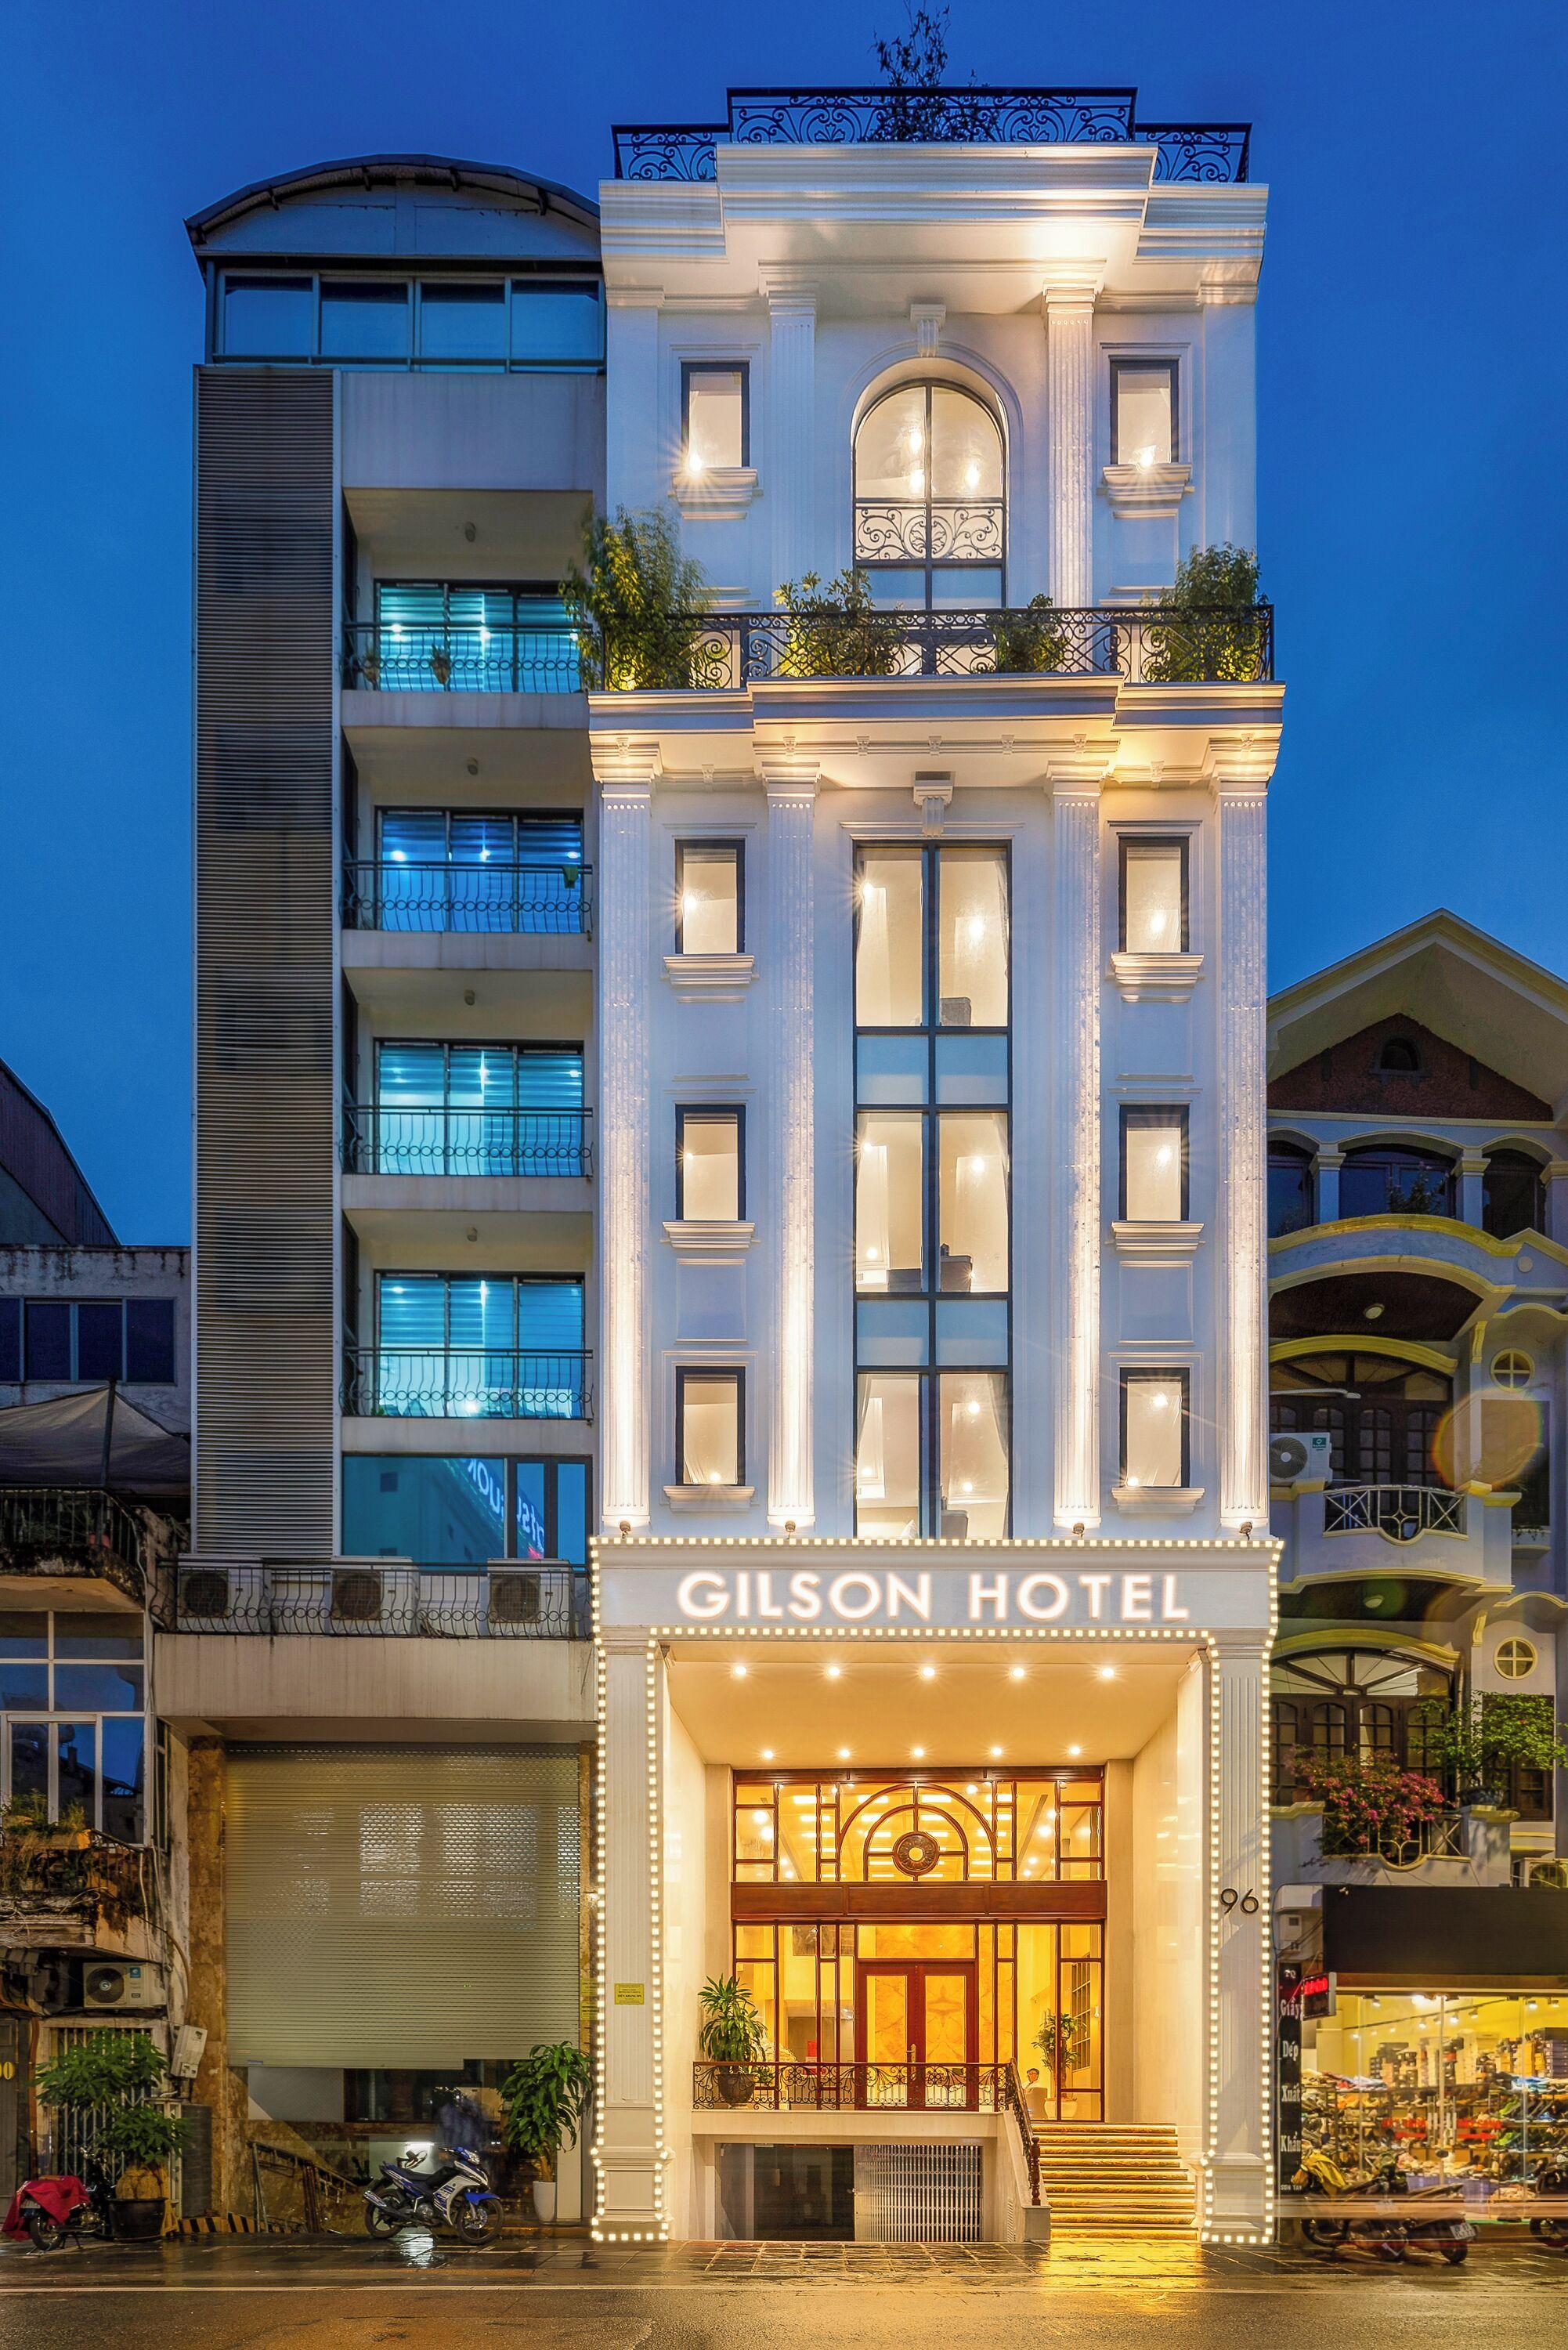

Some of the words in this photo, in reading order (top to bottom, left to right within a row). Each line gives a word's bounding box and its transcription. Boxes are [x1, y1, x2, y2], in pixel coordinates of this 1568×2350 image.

[677, 1571, 932, 1621] GILSON
[968, 1573, 1190, 1621] HOTEL
[1220, 1888, 1259, 1914] 96
[1282, 2041, 1299, 2062] Dép
